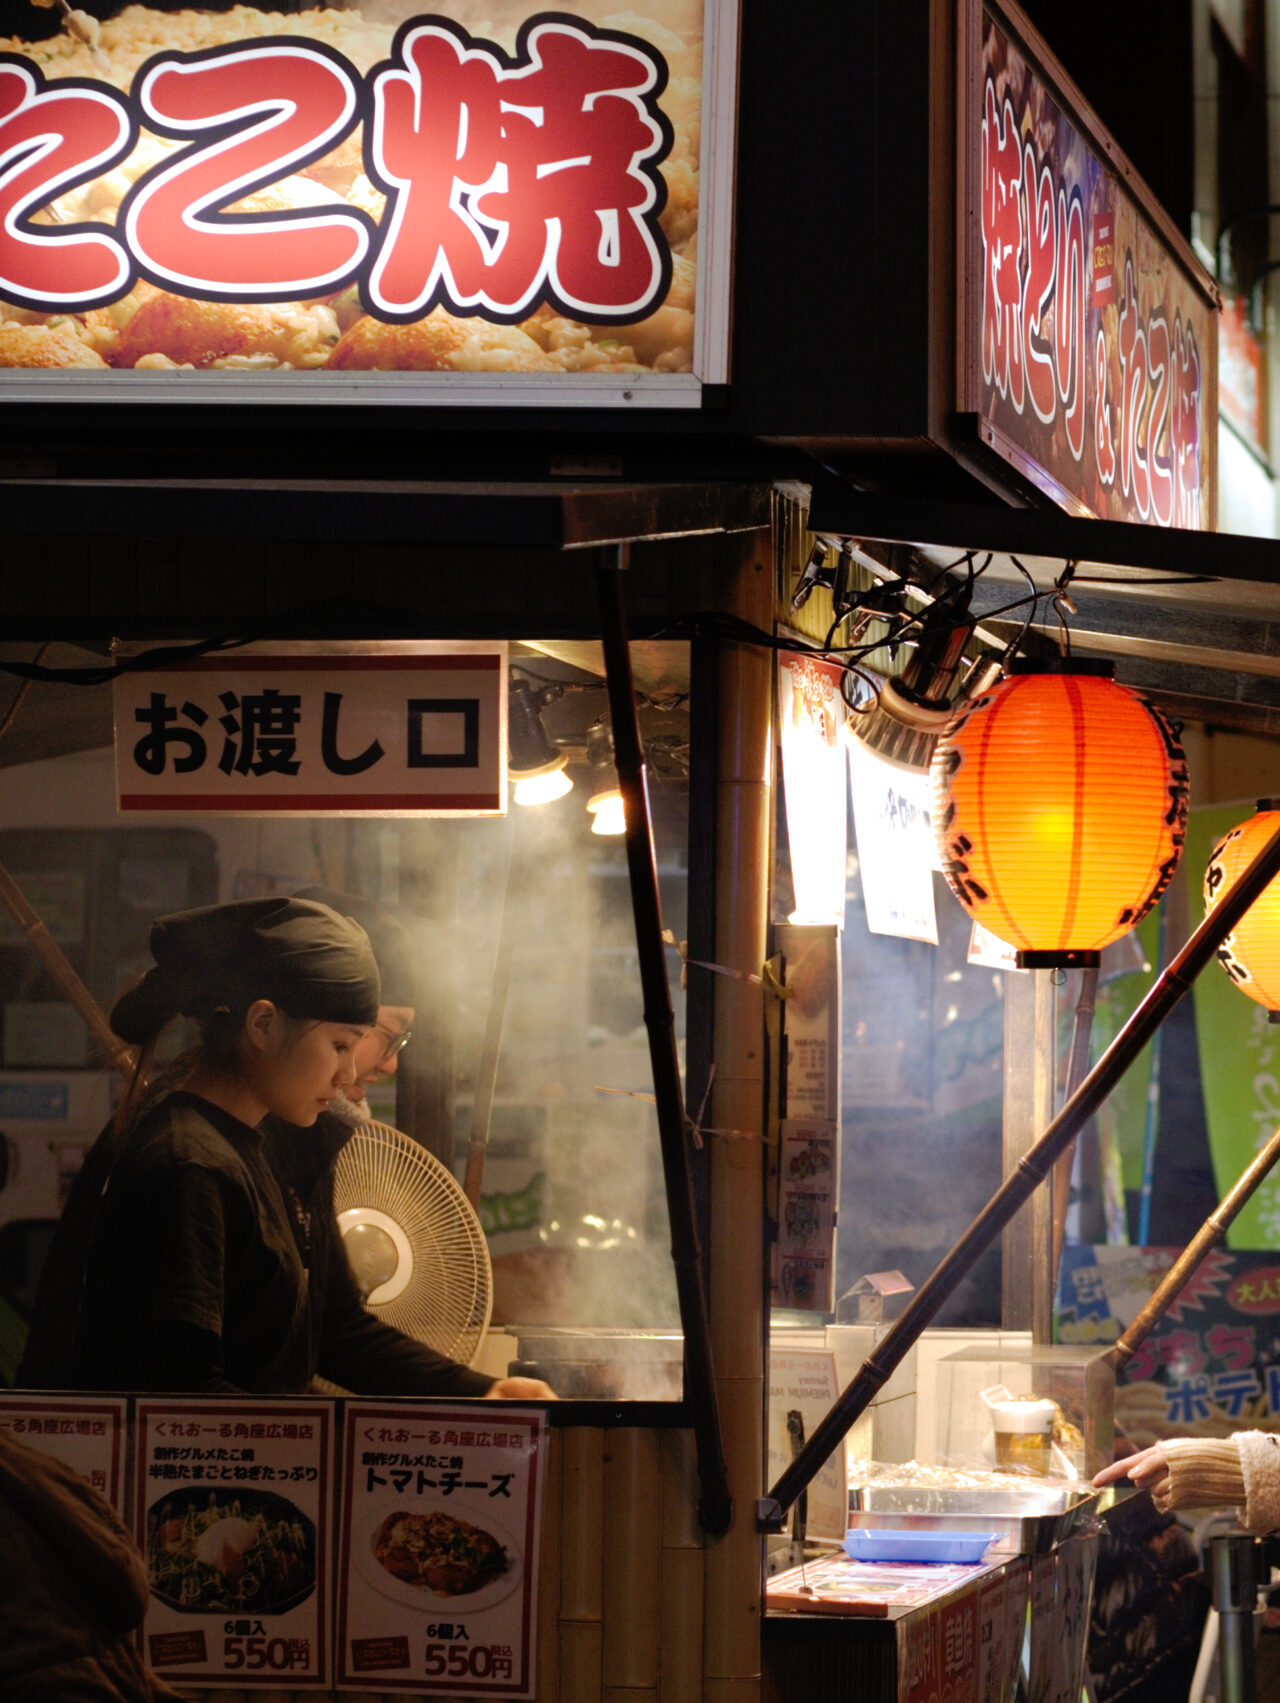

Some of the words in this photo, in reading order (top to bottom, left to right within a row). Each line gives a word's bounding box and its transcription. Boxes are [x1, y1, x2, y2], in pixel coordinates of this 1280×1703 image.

[133, 688, 480, 777] お渡し口
[154, 1421, 314, 1440] くれおーる角座広場店
[363, 1427, 524, 1449] くれおーる角座広場店
[366, 1467, 515, 1498] トマトチーズ
[223, 1620, 267, 1636] 6個入
[426, 1624, 469, 1640] 6個入
[223, 1637, 310, 1670] 550円
[425, 1643, 512, 1679] 550円
